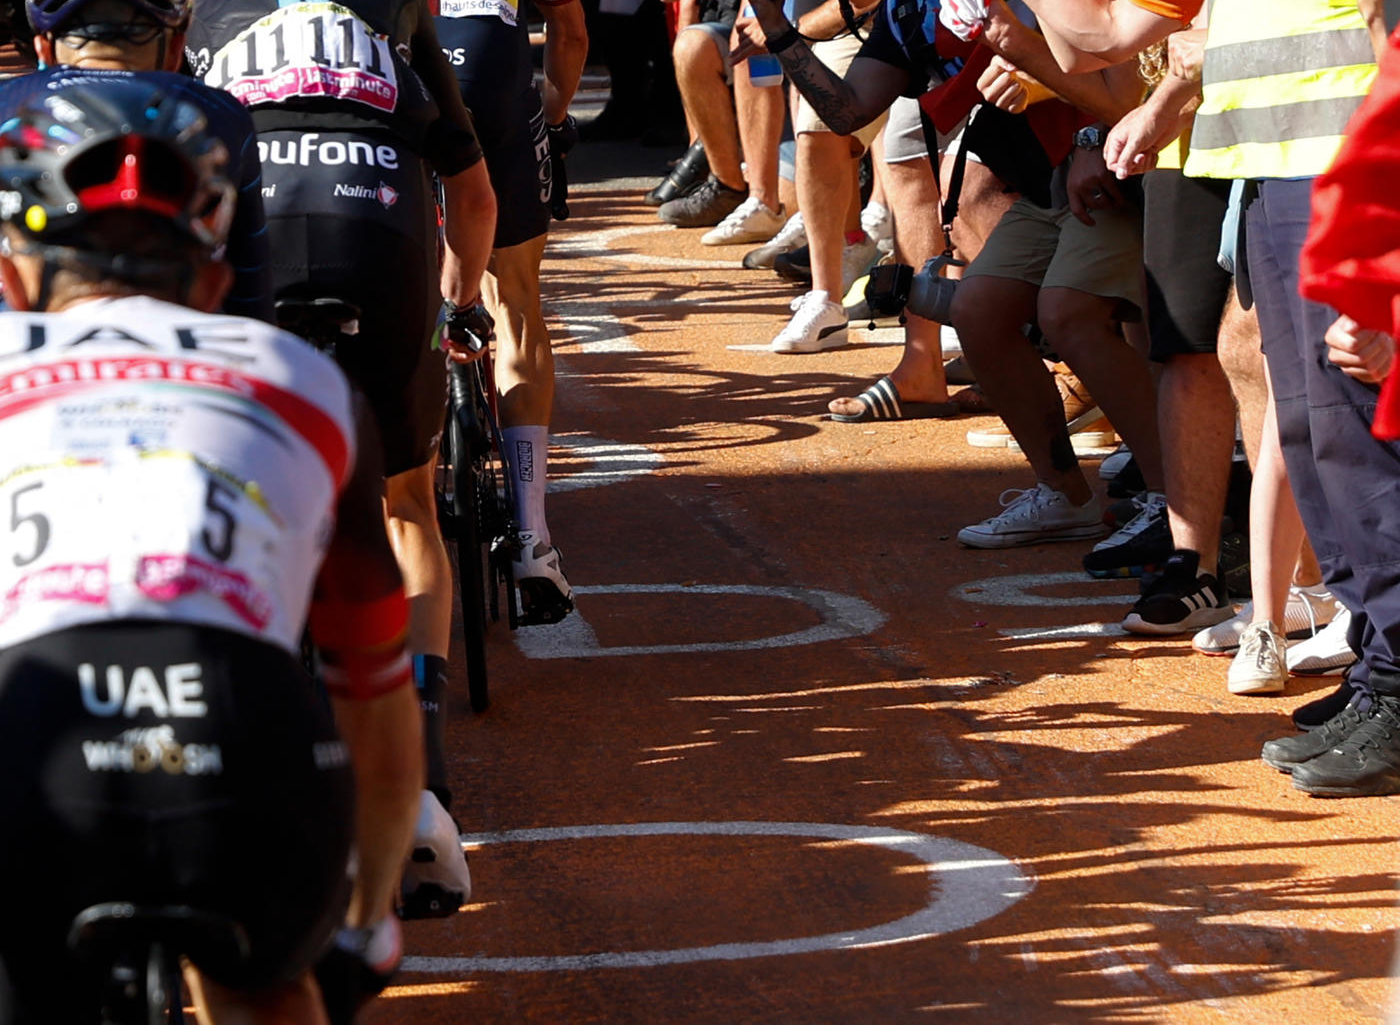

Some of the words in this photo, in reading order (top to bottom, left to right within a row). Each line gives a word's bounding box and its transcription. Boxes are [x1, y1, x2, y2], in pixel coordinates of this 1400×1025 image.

[308, 15, 387, 78] 111
[333, 183, 377, 200] Nalini
[9, 481, 51, 568] 5
[203, 480, 237, 563] 5
[77, 662, 208, 718] UAE
